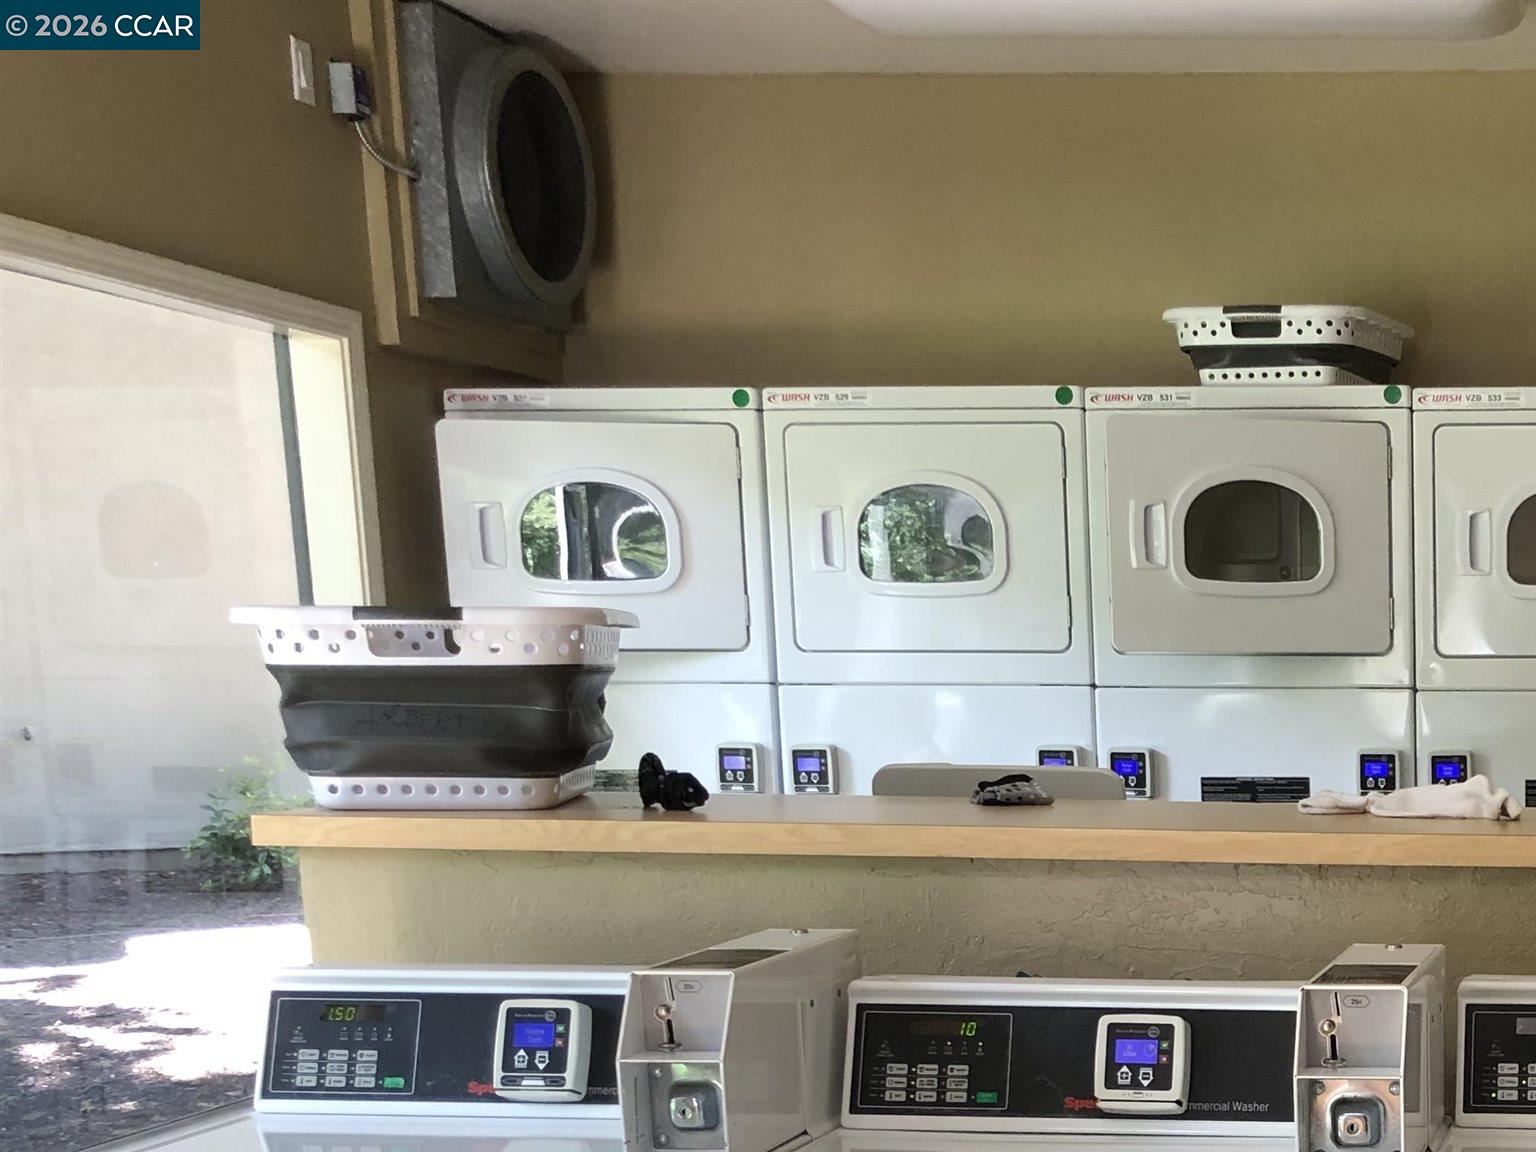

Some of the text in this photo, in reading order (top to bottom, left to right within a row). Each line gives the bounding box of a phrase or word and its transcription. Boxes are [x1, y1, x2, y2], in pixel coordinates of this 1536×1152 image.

[781, 393, 810, 402] WASH
[1105, 394, 1134, 402] WASH
[1432, 394, 1462, 403] WASH
[960, 1022, 977, 1036] 10
[467, 1081, 495, 1096] Spe
[1064, 1096, 1270, 1112] Spe mmercial Washer
